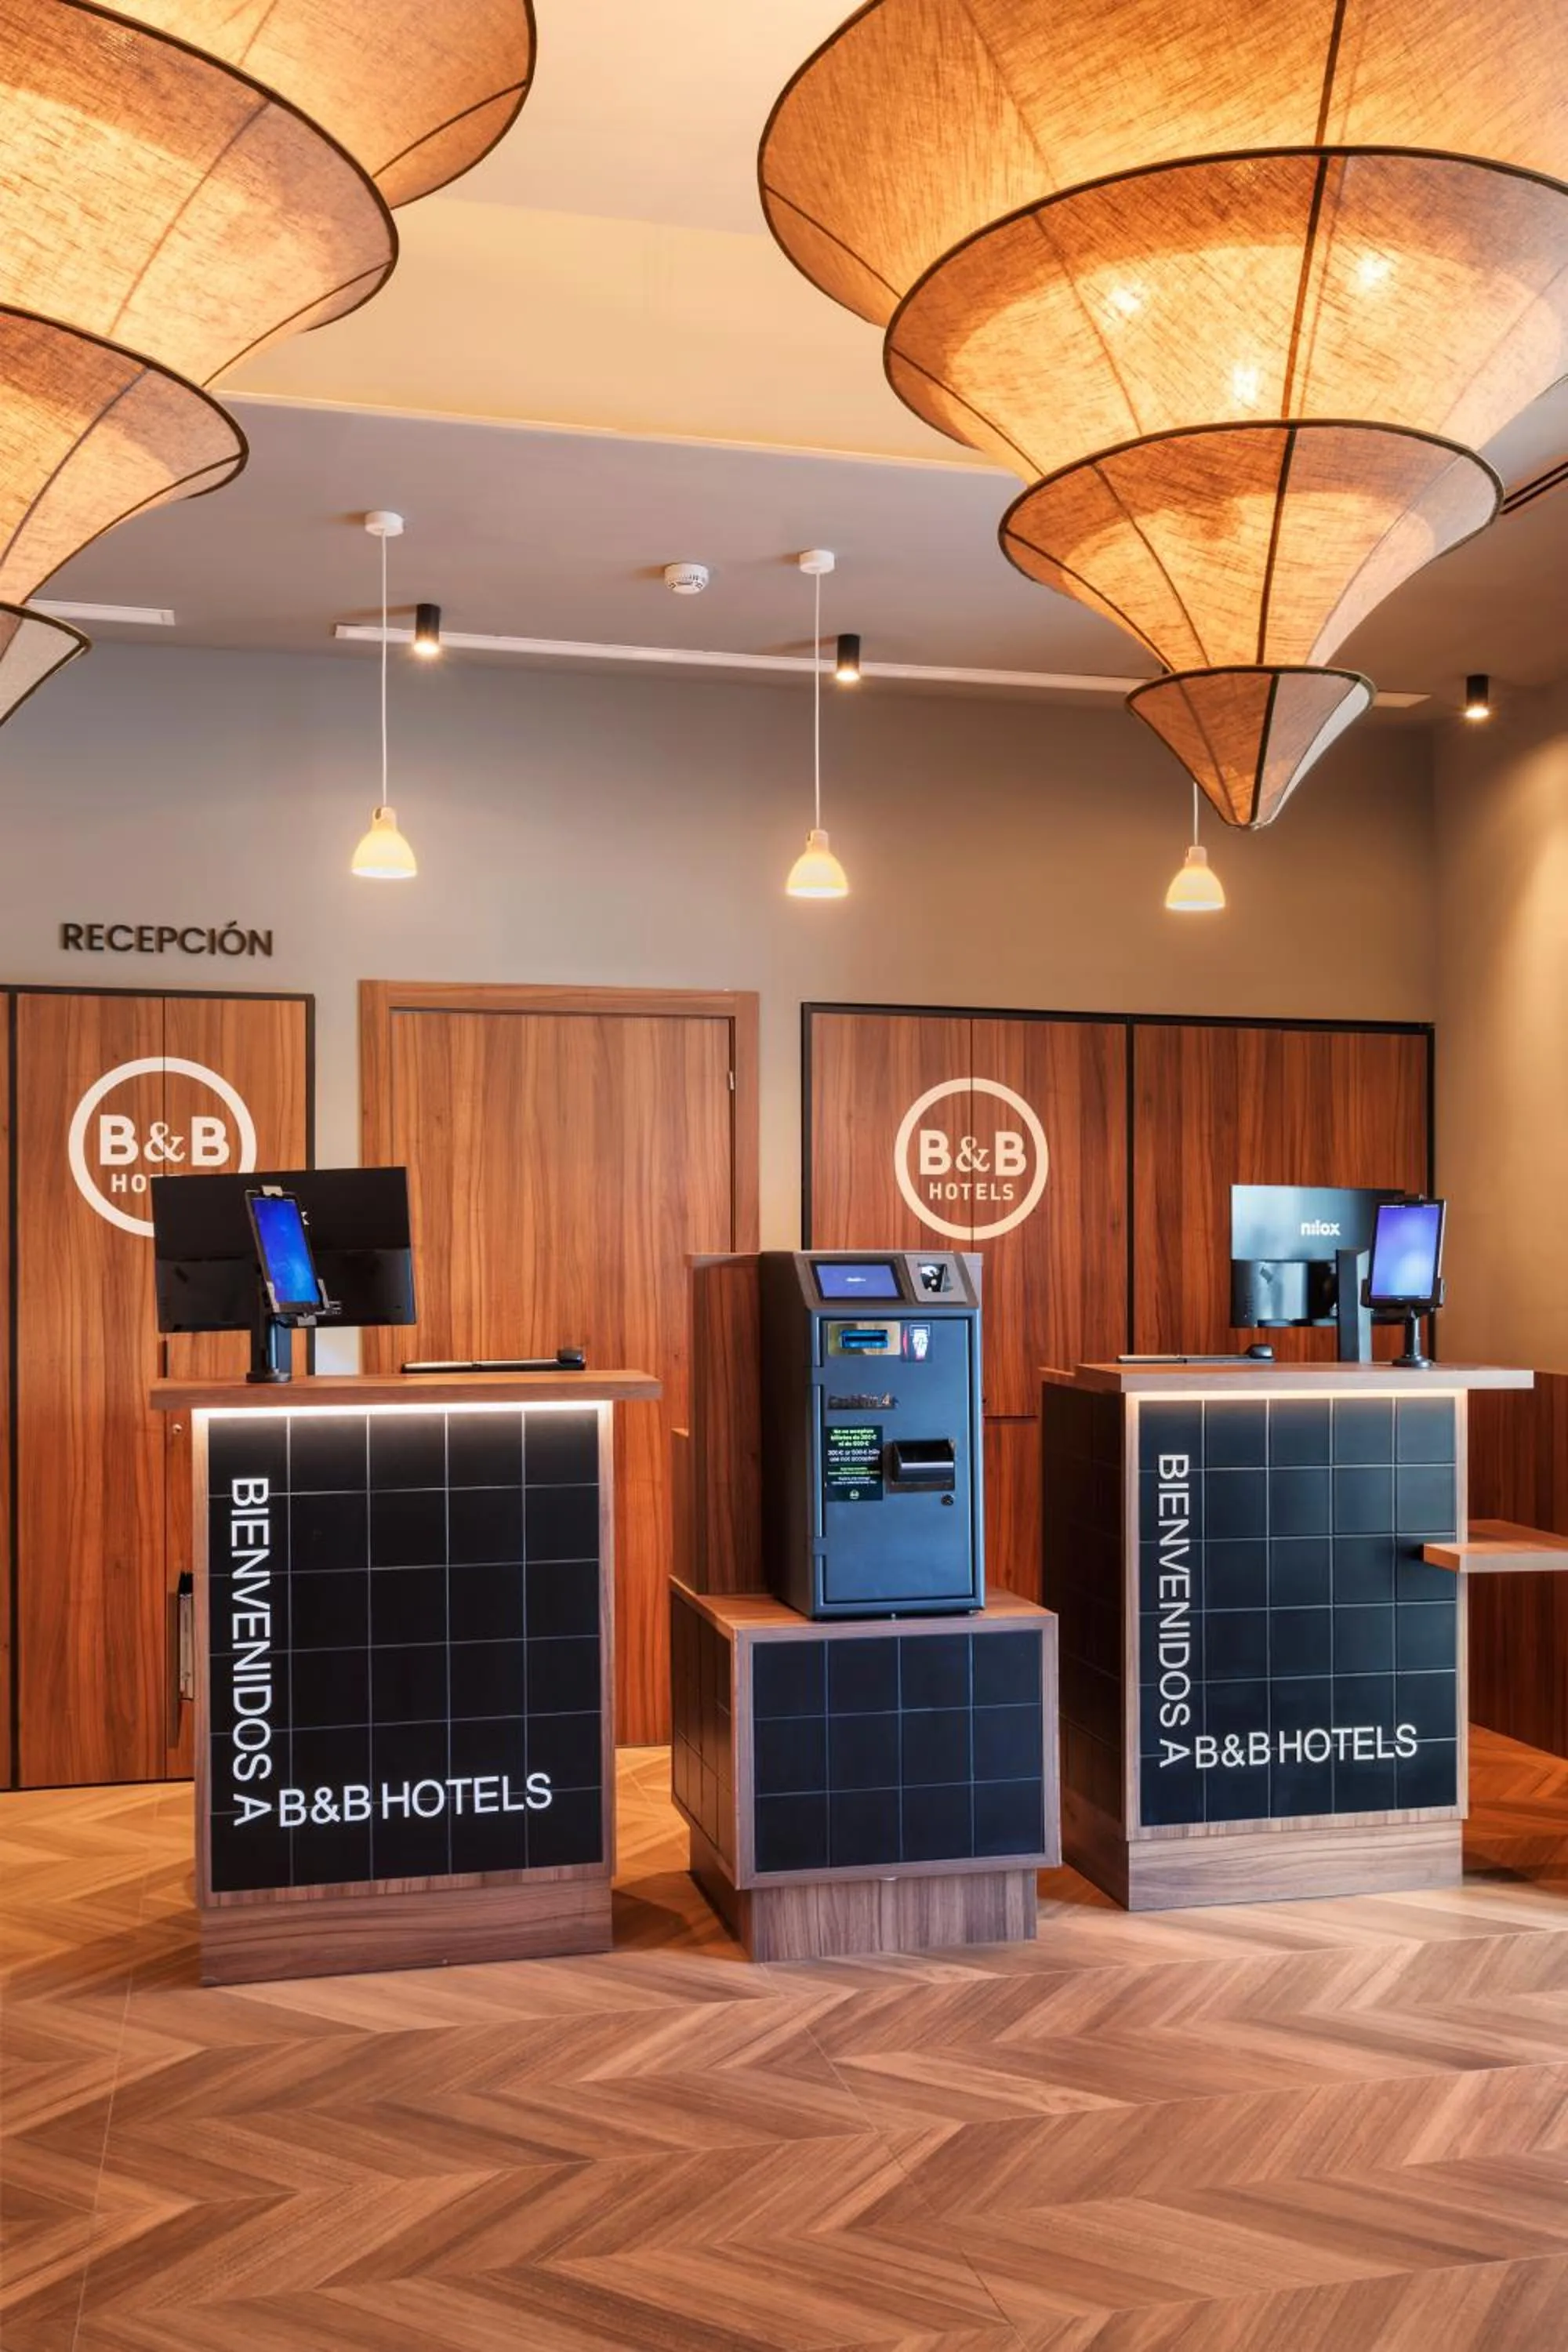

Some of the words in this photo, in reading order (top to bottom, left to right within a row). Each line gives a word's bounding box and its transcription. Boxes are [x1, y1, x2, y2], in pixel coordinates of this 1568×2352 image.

[62, 920, 273, 956] RECEPCIÓN
[100, 1114, 230, 1167] B&B
[920, 1129, 1027, 1176] B&B
[928, 1182, 1014, 1200] HOTELS
[1300, 1219, 1341, 1236] nilox
[1158, 1454, 1191, 1728] BIENVENIDOS
[230, 1477, 272, 1782] BIENVENIDOS
[1159, 1738, 1190, 1768] A
[1195, 1731, 1272, 1769] B&B
[1278, 1723, 1418, 1764] HOTELS
[233, 1793, 272, 1826] A
[278, 1784, 372, 1828] B&B
[381, 1773, 553, 1819] HOTELS
